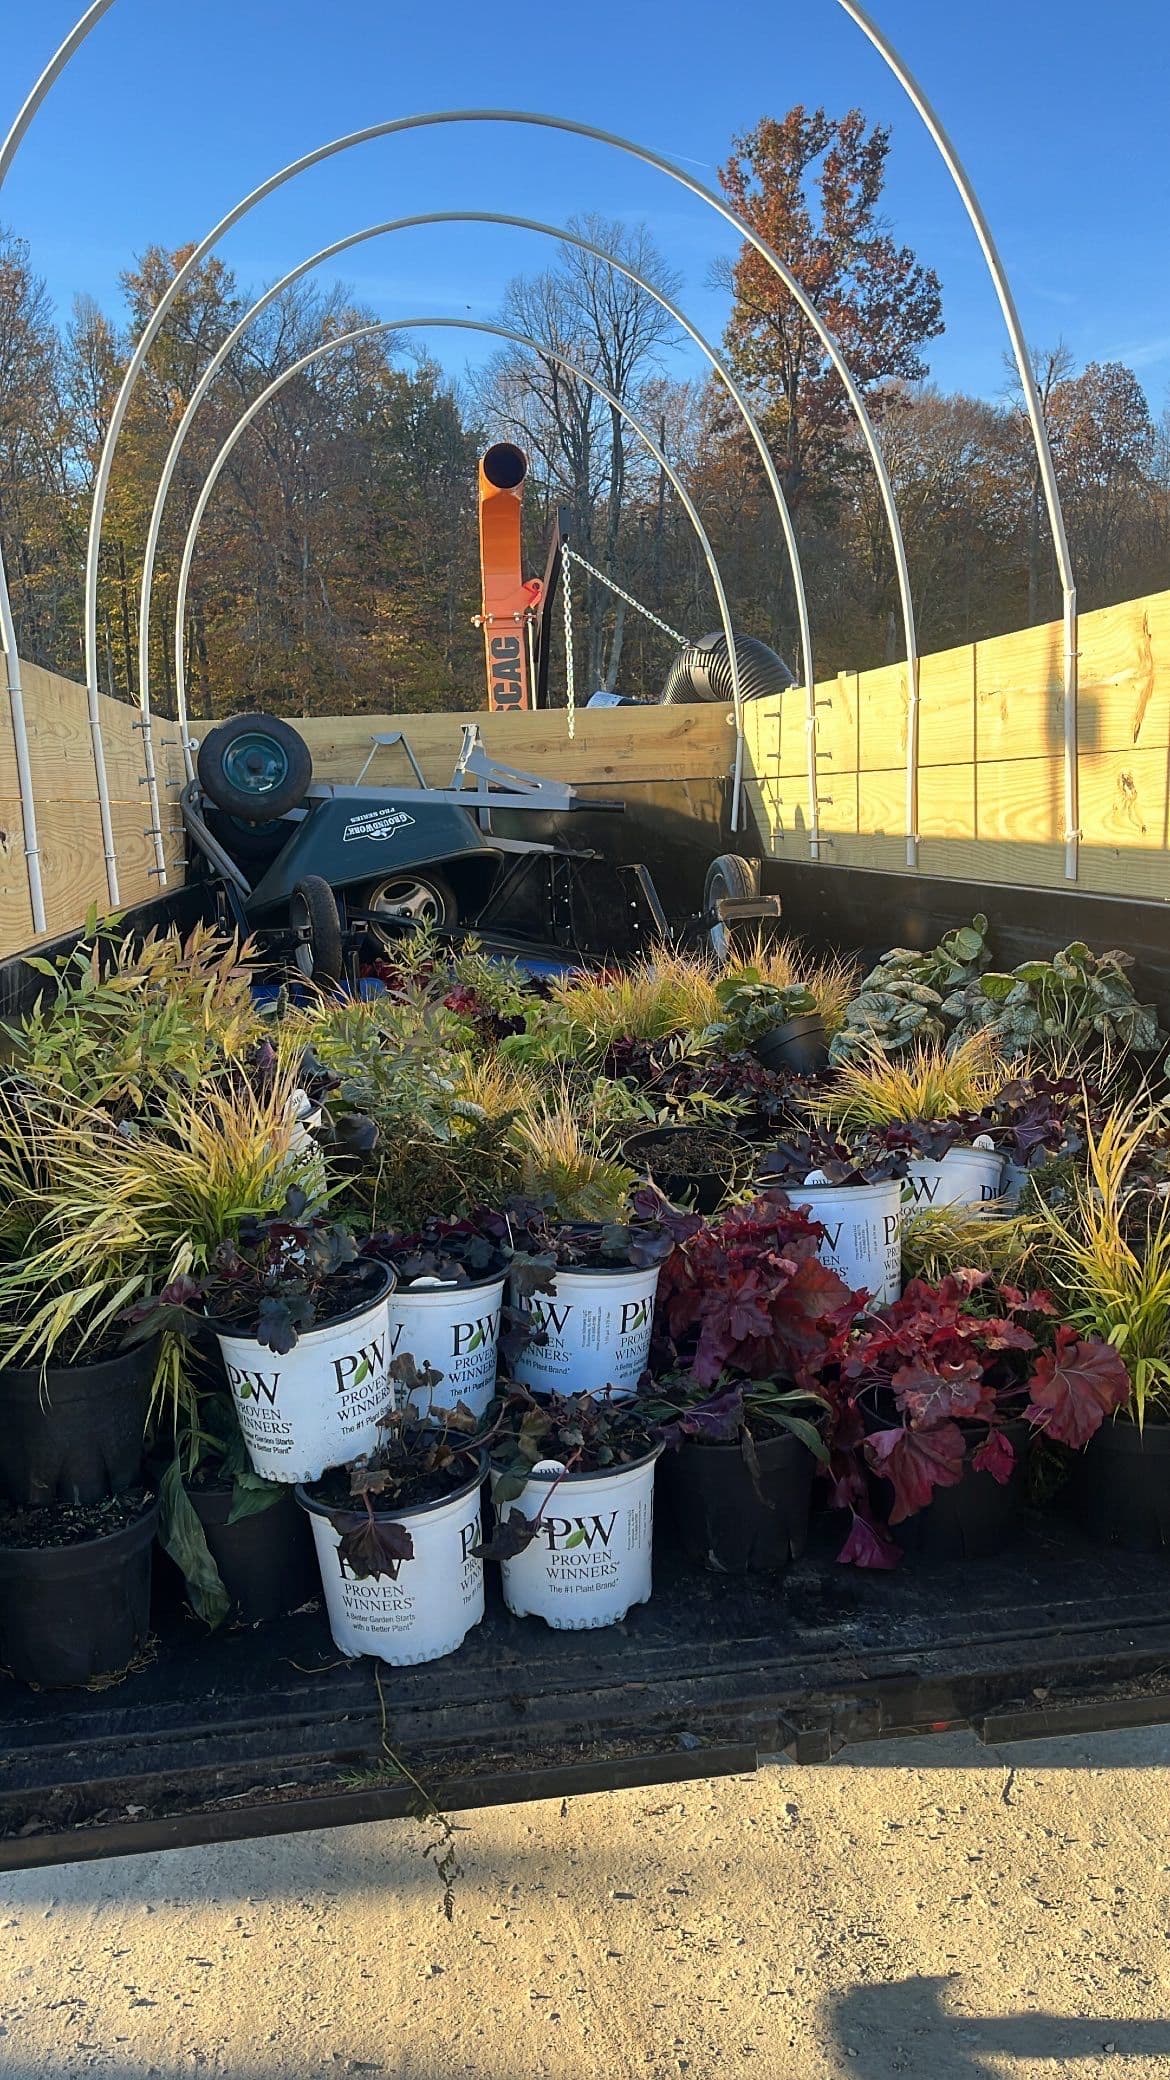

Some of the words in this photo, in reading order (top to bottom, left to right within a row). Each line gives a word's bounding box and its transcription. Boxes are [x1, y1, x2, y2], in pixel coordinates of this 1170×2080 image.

[491, 637, 523, 711] CAG
[817, 1222, 844, 1253] W
[882, 1213, 899, 1245] P
[451, 1309, 500, 1357] PW
[330, 1332, 386, 1395] PW
[226, 1362, 281, 1406] PW
[457, 1512, 481, 1564] P
[543, 1510, 619, 1551] PW
[551, 1550, 612, 1566] PROVEN
[345, 1584, 404, 1598] PROVEN
[549, 1585, 562, 1594] The
[576, 1584, 595, 1593] Plant
[351, 1613, 368, 1622] Better
[396, 1614, 416, 1622] Starts
